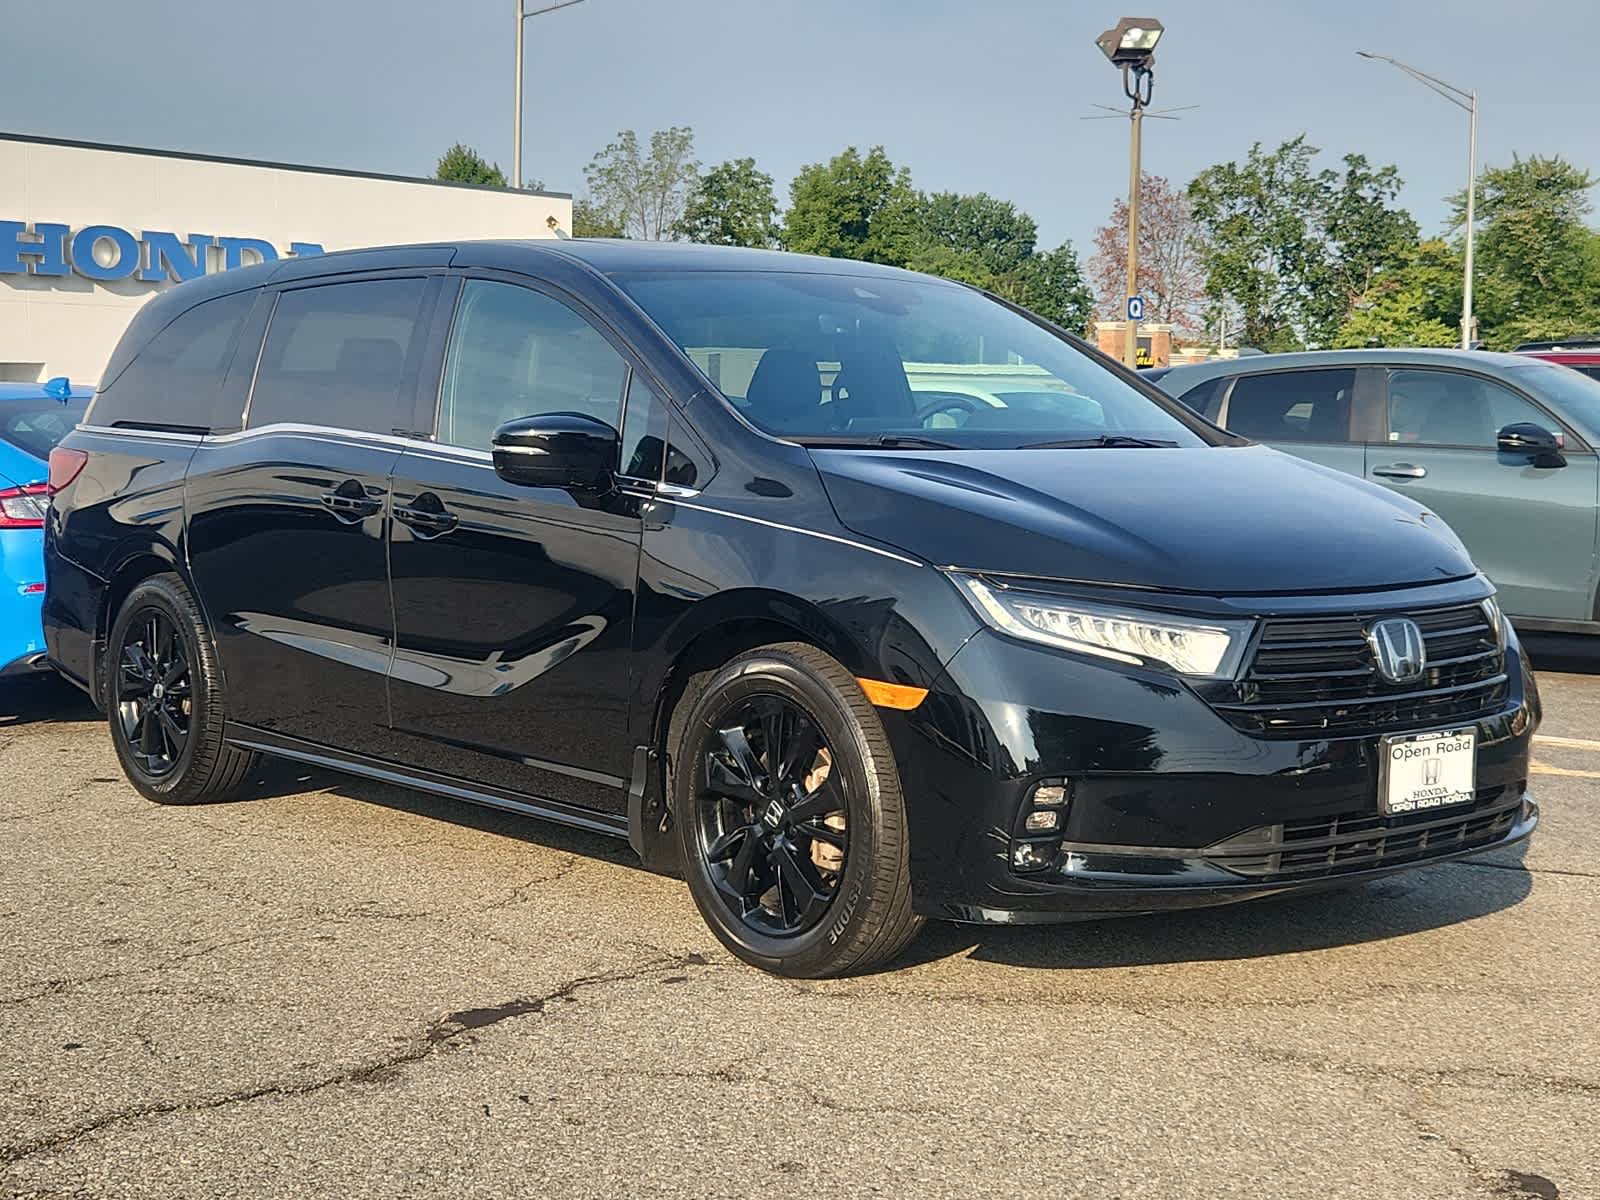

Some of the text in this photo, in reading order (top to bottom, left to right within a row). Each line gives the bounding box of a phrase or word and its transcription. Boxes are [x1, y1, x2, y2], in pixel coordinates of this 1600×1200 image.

[0, 220, 326, 283] HOND
[1129, 300, 1142, 317] Q
[1392, 739, 1471, 762] Open Road
[1413, 786, 1449, 799] HONDA
[1417, 797, 1441, 809] ROAD
[1442, 792, 1471, 805] HONDA
